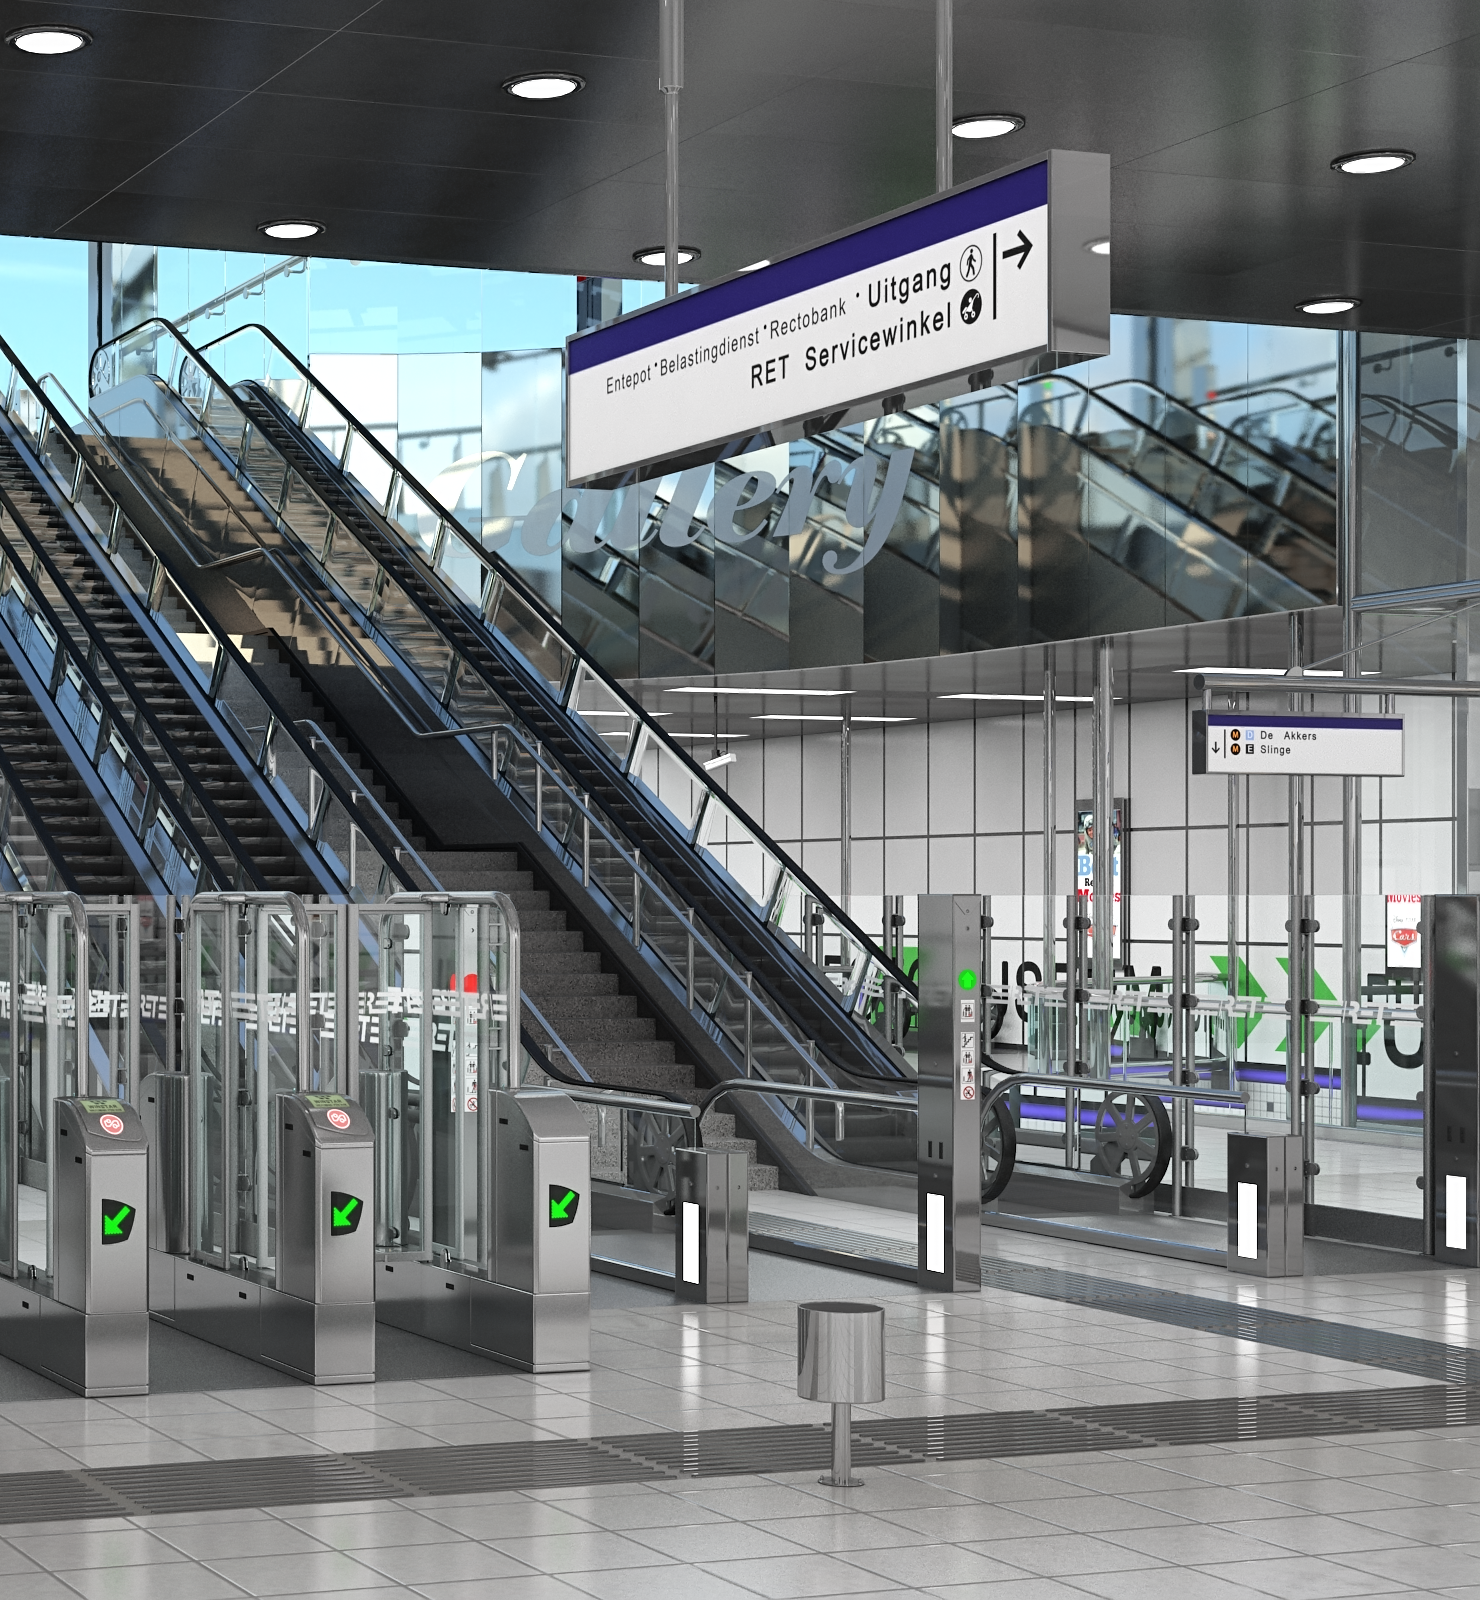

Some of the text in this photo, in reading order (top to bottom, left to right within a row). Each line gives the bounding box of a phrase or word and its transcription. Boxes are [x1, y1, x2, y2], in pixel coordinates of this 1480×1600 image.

[606, 262, 951, 394] Entepot Belastingdienst Rectobank Uitgang
[751, 302, 951, 389] RET Servicewinkel
[1260, 730, 1274, 741] De
[1283, 731, 1317, 742] Akkers
[1260, 744, 1291, 756] Slinge
[1392, 930, 1416, 941] Cars
